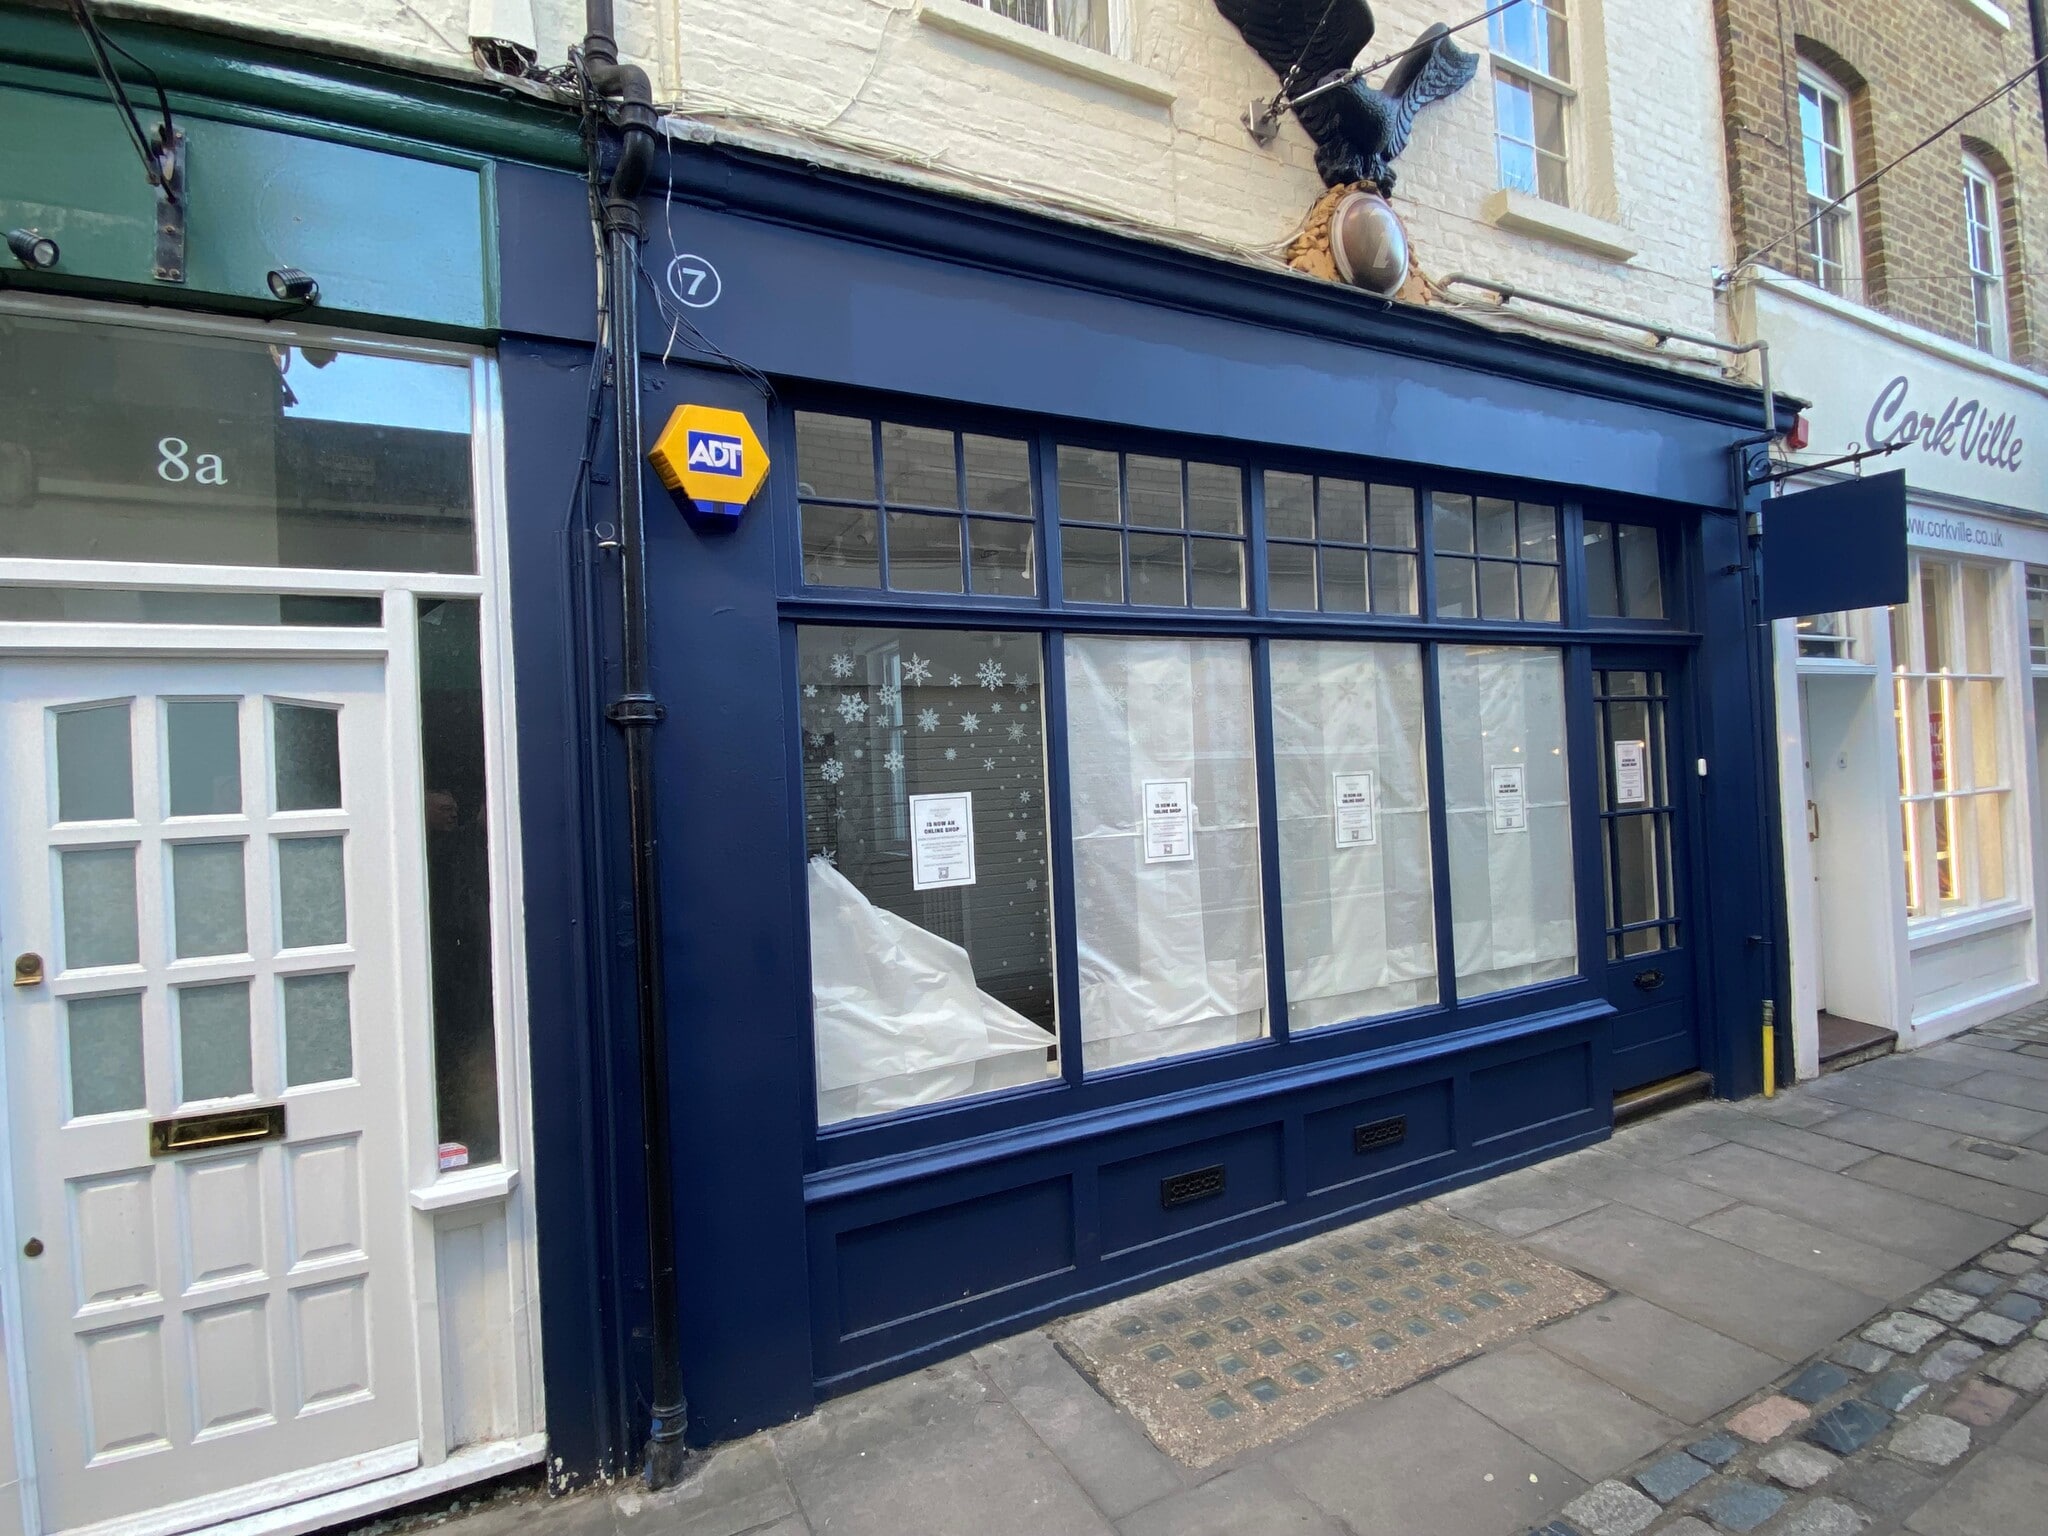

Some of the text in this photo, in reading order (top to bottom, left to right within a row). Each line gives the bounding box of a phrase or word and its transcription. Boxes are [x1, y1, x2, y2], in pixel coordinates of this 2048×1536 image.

[682, 267, 707, 296] 7
[157, 437, 229, 486] 8a
[688, 439, 742, 470] ADT
[1907, 518, 2003, 548] ww.corkville.co.uk
